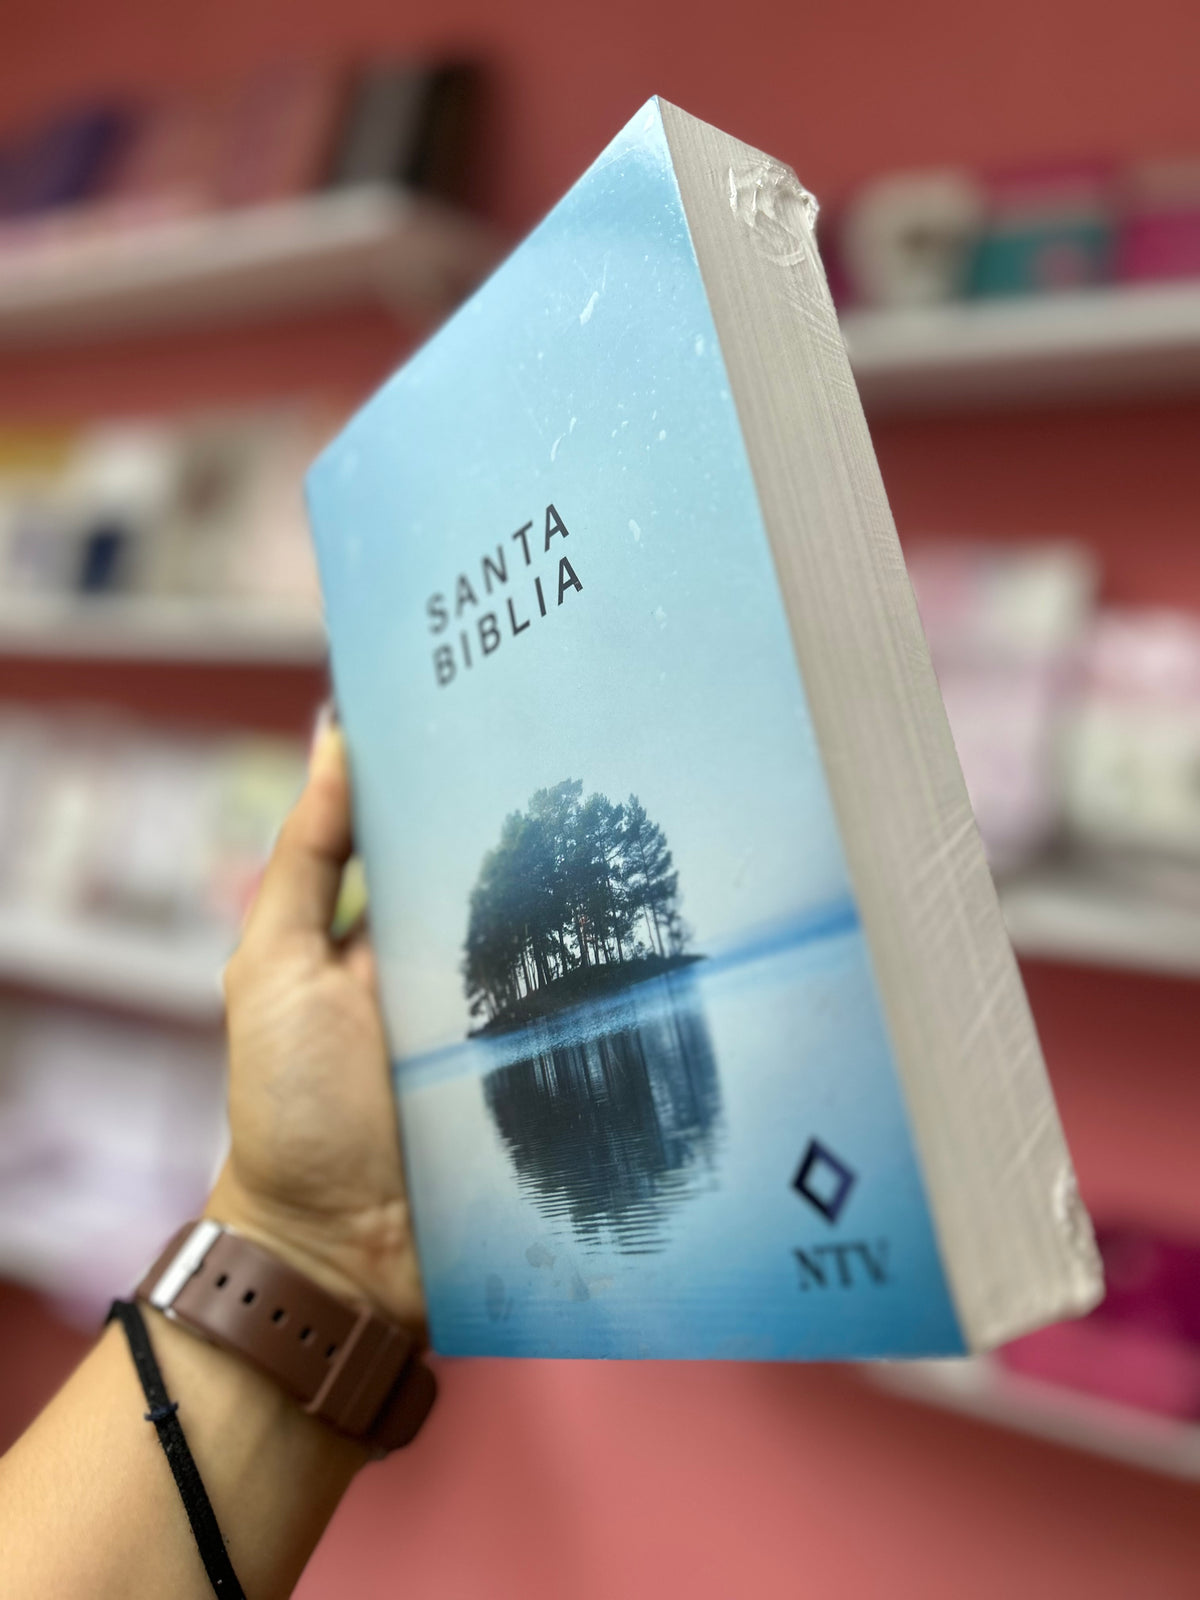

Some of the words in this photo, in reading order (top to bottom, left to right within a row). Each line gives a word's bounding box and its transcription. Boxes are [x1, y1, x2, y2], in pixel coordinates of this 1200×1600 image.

[426, 503, 569, 635] SANTA
[432, 556, 583, 687] BIBLIA
[793, 1236, 891, 1290] NTV
